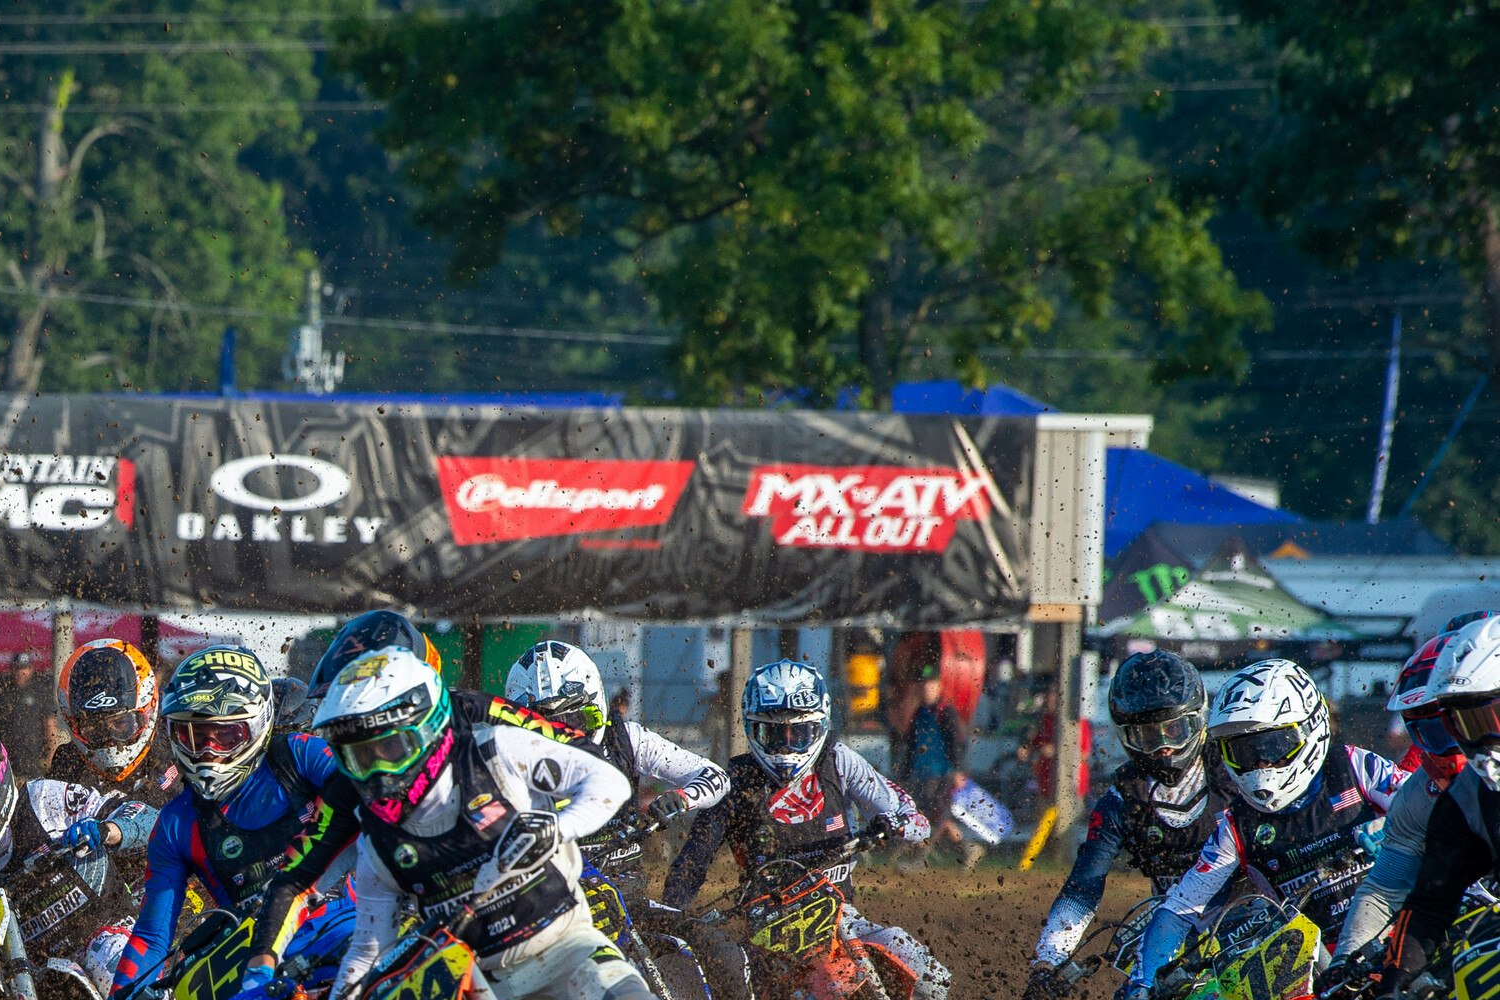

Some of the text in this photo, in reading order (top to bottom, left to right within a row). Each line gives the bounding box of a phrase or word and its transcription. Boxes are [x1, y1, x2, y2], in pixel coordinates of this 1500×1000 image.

[176, 511, 385, 546] OAKLEY
[777, 515, 943, 548] ALL OUT
[188, 651, 261, 679] SHOEI
[488, 914, 517, 937] 2021
